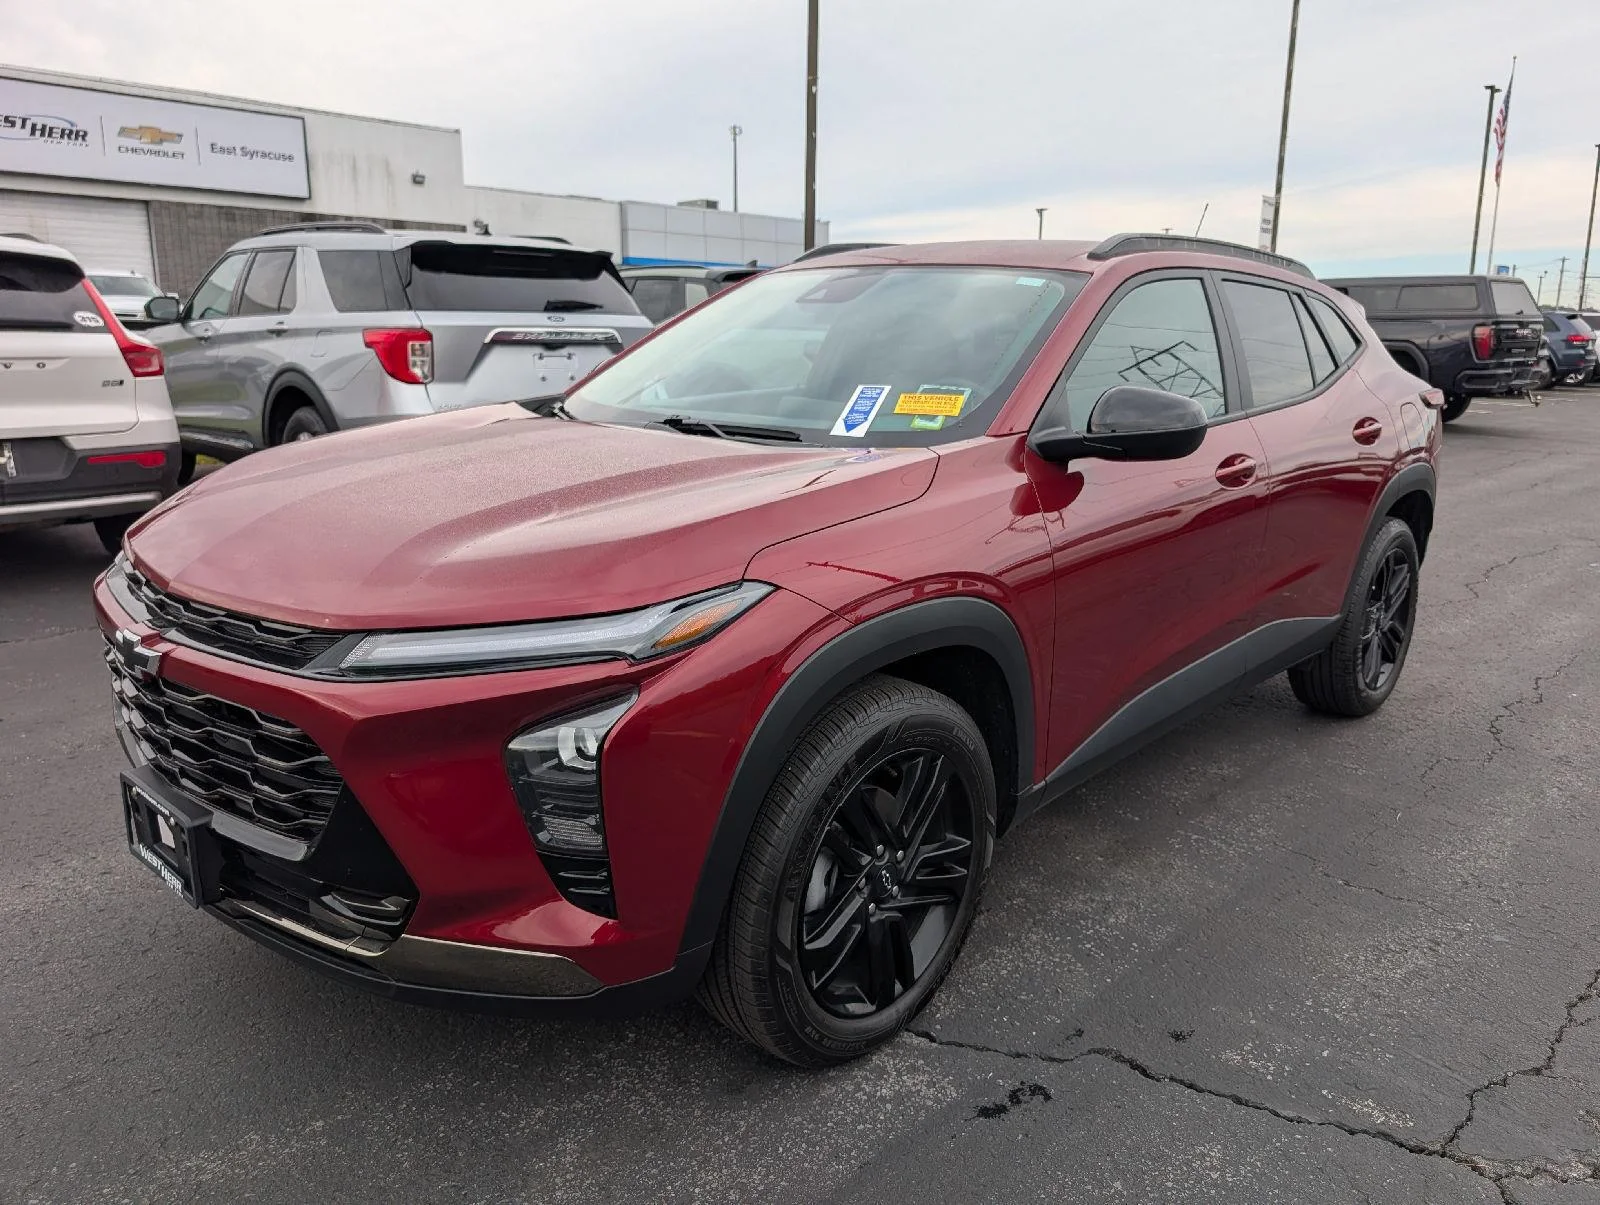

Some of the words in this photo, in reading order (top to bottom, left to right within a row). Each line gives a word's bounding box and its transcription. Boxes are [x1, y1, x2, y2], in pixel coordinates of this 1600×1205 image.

[29, 122, 88, 142] HERR
[118, 145, 185, 160] CHEVROLET
[210, 142, 237, 156] East
[240, 146, 294, 162] Syracuse
[140, 843, 162, 870] WEST
[161, 866, 182, 892] HERR
